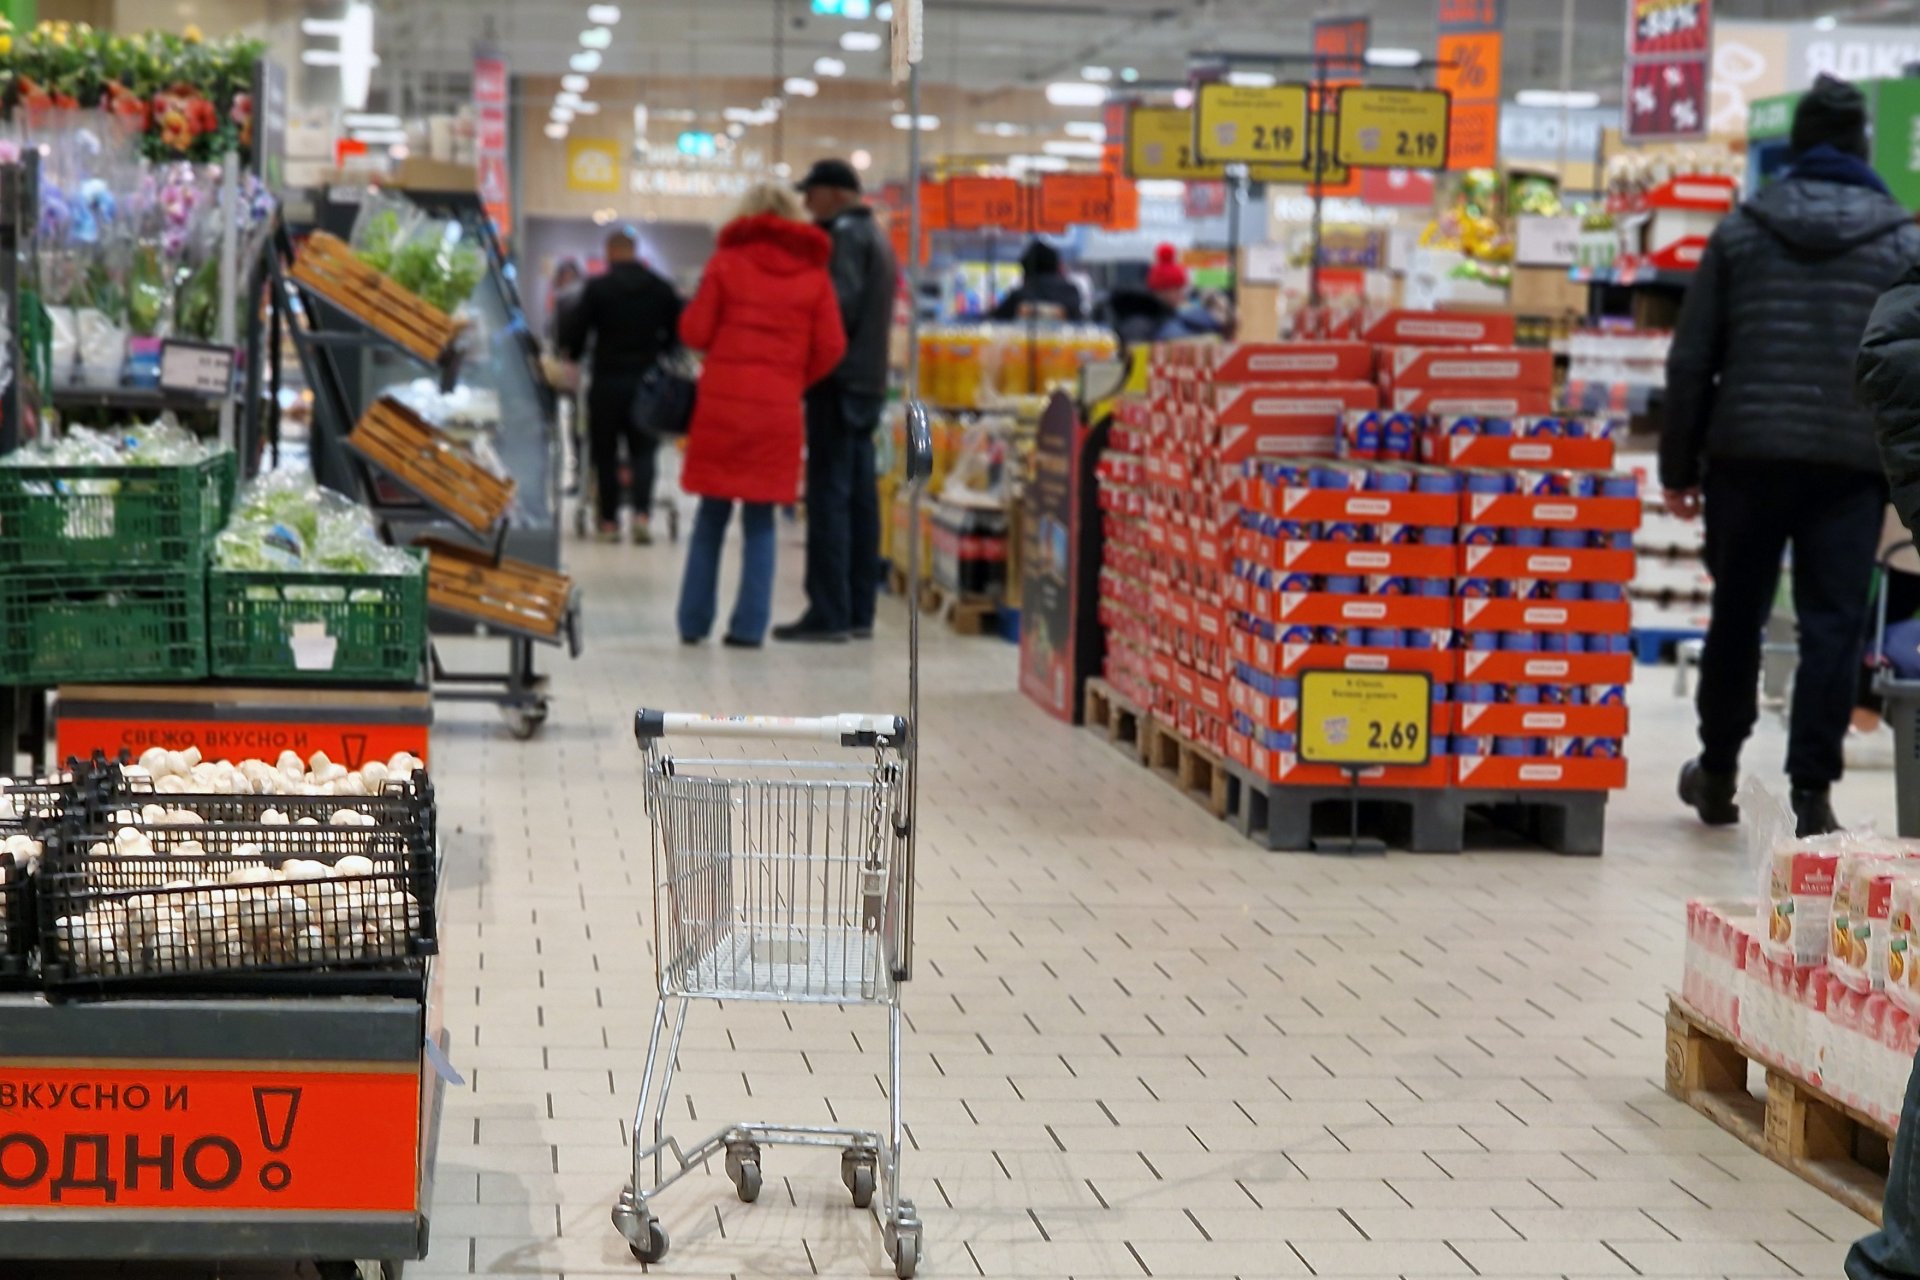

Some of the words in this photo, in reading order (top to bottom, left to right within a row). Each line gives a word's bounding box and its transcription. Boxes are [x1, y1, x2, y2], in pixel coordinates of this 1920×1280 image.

[1252, 126, 1293, 151] 2.19
[1396, 131, 1438, 157] 2.19
[205, 729, 289, 748] ВКУСНО
[294, 730, 308, 748] И
[1367, 720, 1419, 751] 2.69
[0, 1083, 150, 1110] ВКУСНО
[164, 1085, 188, 1111] И
